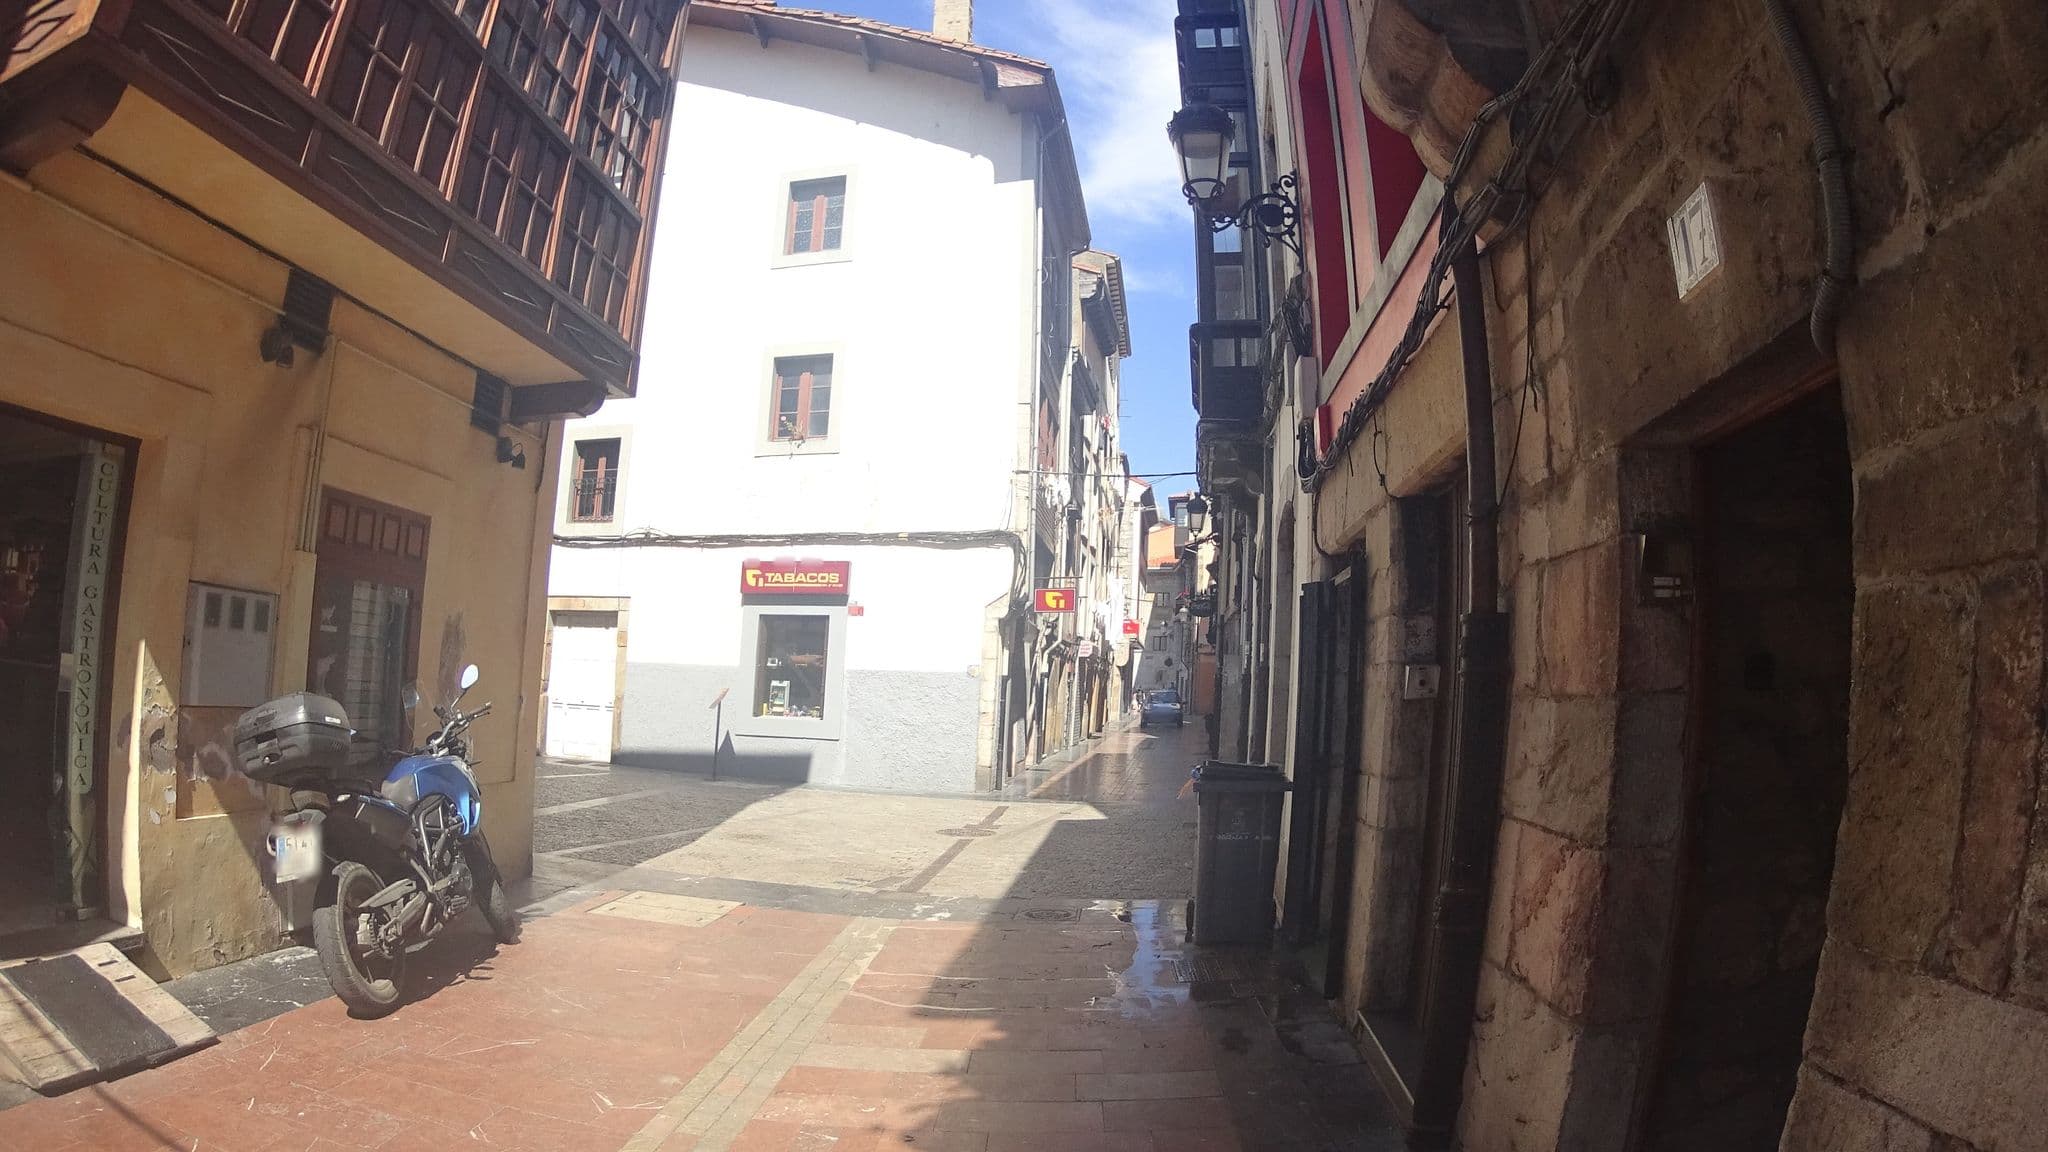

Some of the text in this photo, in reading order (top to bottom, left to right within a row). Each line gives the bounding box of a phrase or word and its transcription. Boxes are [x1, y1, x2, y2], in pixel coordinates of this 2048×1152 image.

[1677, 199, 1709, 277] 17
[765, 572, 840, 583] TABACOS
[73, 462, 114, 786] CULTURA GASTRONÓMICA
